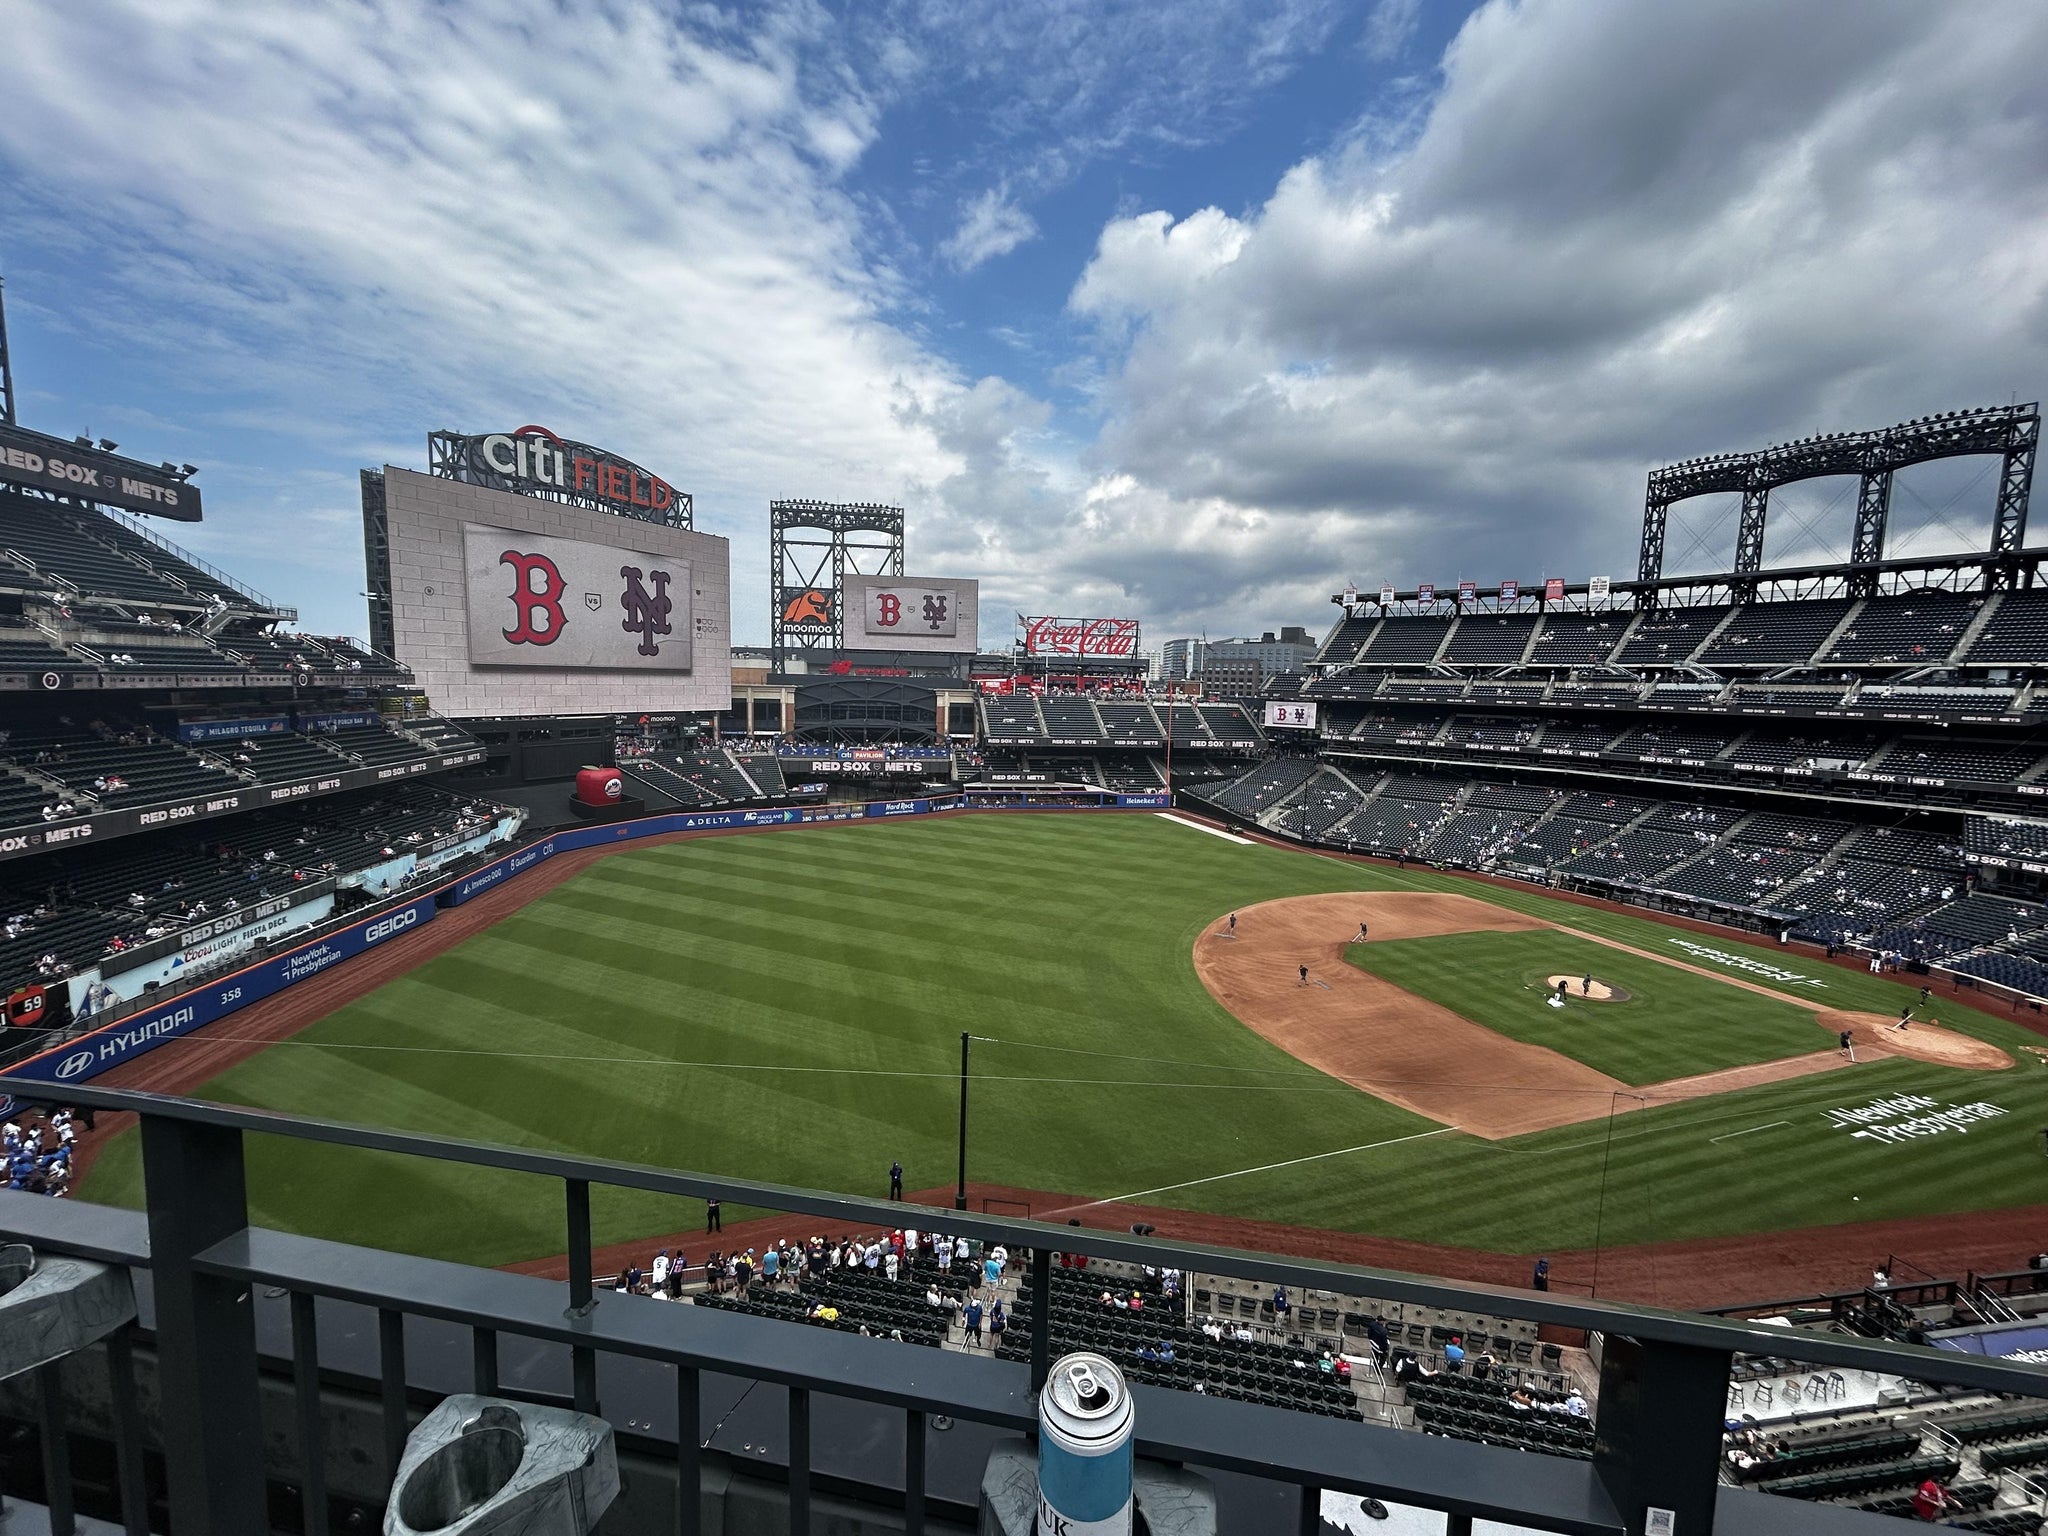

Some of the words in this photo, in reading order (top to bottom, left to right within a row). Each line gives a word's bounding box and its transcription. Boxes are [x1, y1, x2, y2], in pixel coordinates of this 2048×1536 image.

[482, 434, 565, 486] citi
[574, 456, 672, 510] FIELD
[48, 458, 99, 487] SOX
[120, 477, 178, 506] METS
[500, 550, 570, 646] B
[876, 594, 901, 626] B
[784, 624, 832, 634] moomoo
[209, 726, 239, 736] MILAGRO
[240, 724, 267, 733] TEQUILA
[378, 770, 391, 779] RED
[393, 767, 406, 776] SOX
[411, 763, 426, 773] METS
[813, 762, 840, 771] RED
[843, 762, 870, 771] SOX
[885, 762, 922, 771] METS
[1784, 768, 1812, 776] METS
[1872, 774, 1895, 782] SOX
[272, 788, 290, 799] RED
[291, 784, 310, 796] SOX
[318, 779, 340, 790] METS
[2017, 786, 2044, 794] RED
[140, 812, 166, 825] RED
[169, 805, 195, 819] SOX
[206, 798, 238, 812] METS
[885, 803, 899, 811] Hard
[900, 802, 914, 810] Rock
[698, 816, 730, 825] DELTA
[46, 824, 92, 843] METS
[432, 842, 445, 852] RED
[446, 836, 459, 846] SOX
[543, 843, 554, 855] citi
[515, 852, 536, 868] Guardian
[1981, 856, 2008, 867] SOX
[472, 875, 491, 889] Invesco
[181, 924, 212, 947] RED
[214, 914, 242, 934] SOX
[256, 897, 290, 918] METS
[365, 908, 416, 942] GEICO
[184, 944, 212, 963] Coors
[213, 935, 237, 951] LIGHT
[243, 926, 267, 940] FIESTA
[269, 916, 287, 930] DECK
[291, 950, 341, 979] Presbyterian
[221, 987, 241, 1004] 358
[24, 996, 42, 1012] 59
[100, 1006, 194, 1060] HYUNDAI
[1868, 1101, 2010, 1142] Presbyterian
